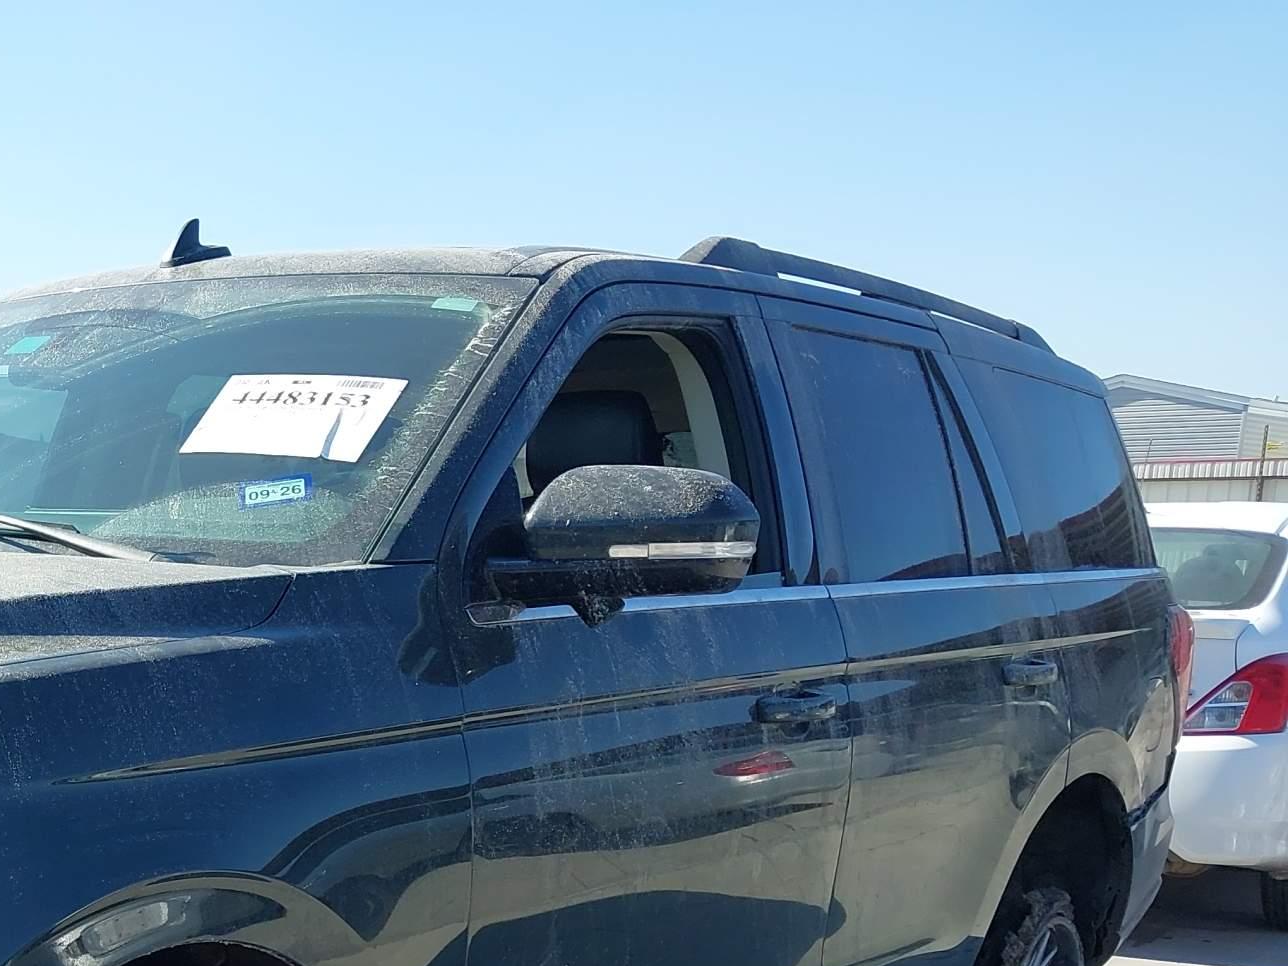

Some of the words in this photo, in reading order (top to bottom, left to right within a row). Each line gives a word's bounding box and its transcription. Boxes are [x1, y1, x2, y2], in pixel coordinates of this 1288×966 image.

[232, 391, 370, 407] 44483153
[249, 489, 270, 501] 09
[280, 485, 302, 497] 26
